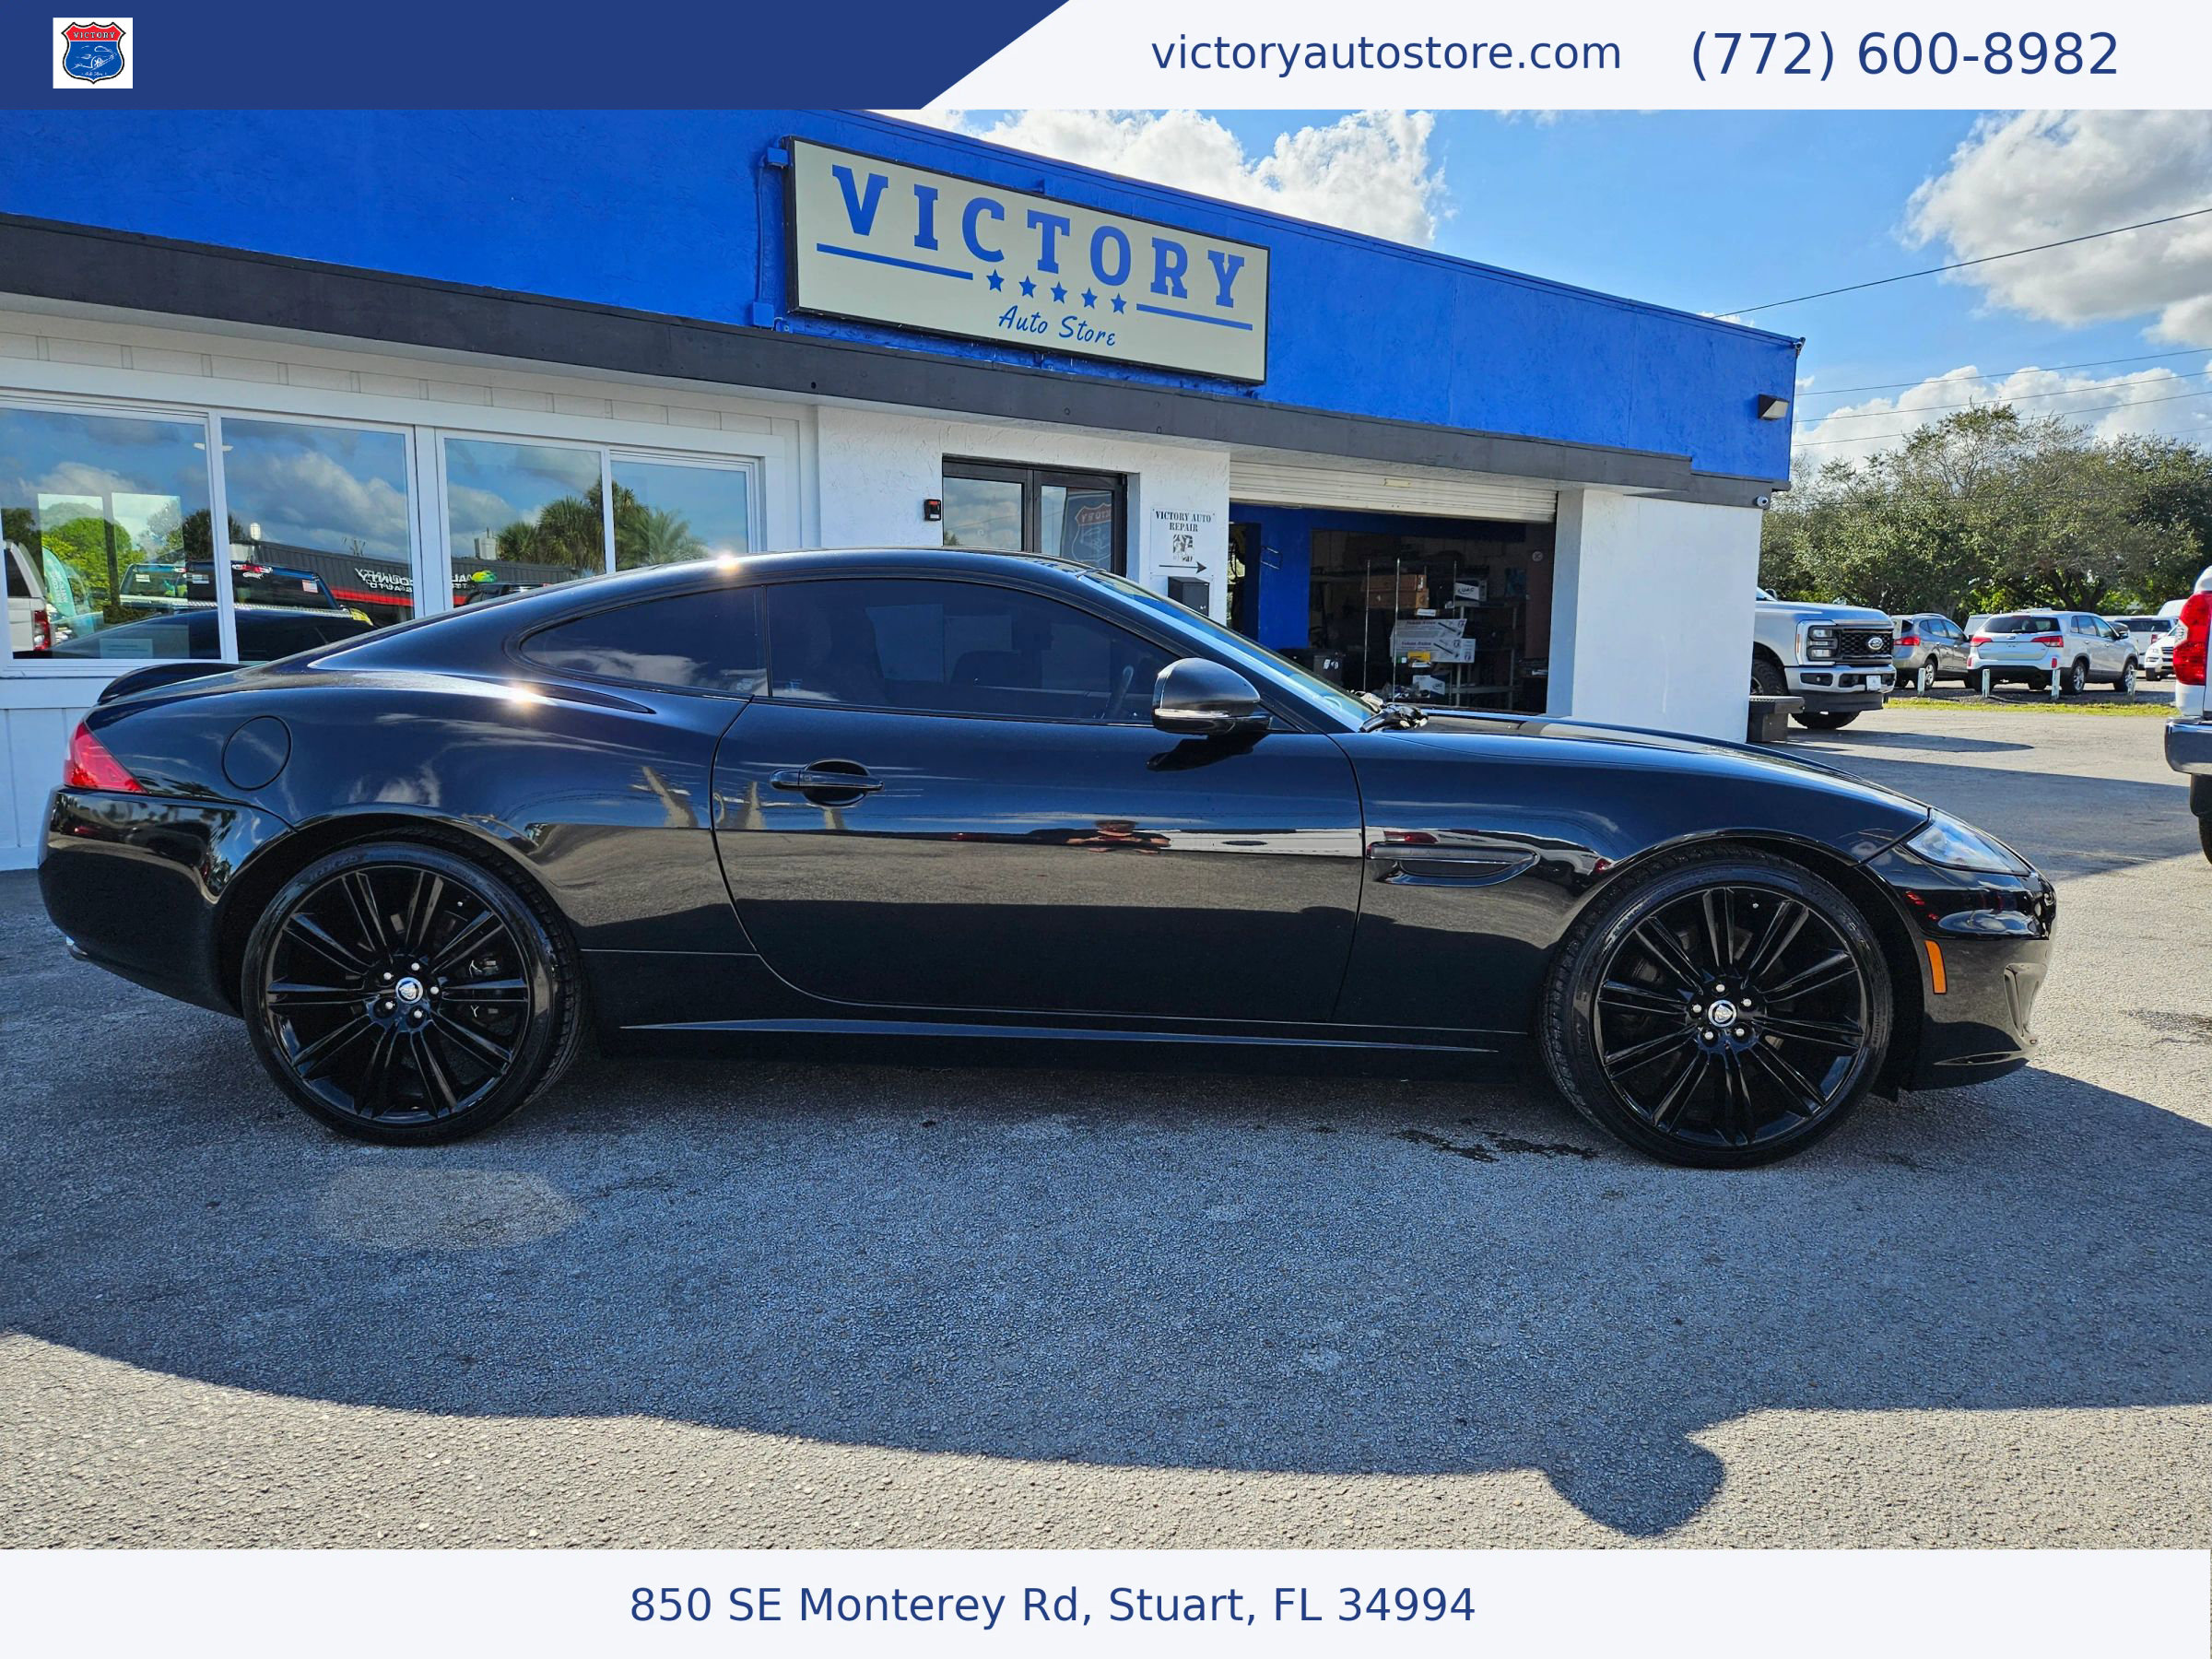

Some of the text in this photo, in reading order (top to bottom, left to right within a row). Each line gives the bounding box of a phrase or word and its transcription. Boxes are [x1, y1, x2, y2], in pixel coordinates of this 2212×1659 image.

[831, 163, 1245, 308] VICTORY
[998, 304, 1116, 347] Auto Store
[1155, 511, 1212, 524] VICTORY AUTO
[1169, 522, 1199, 533] REPAIR
